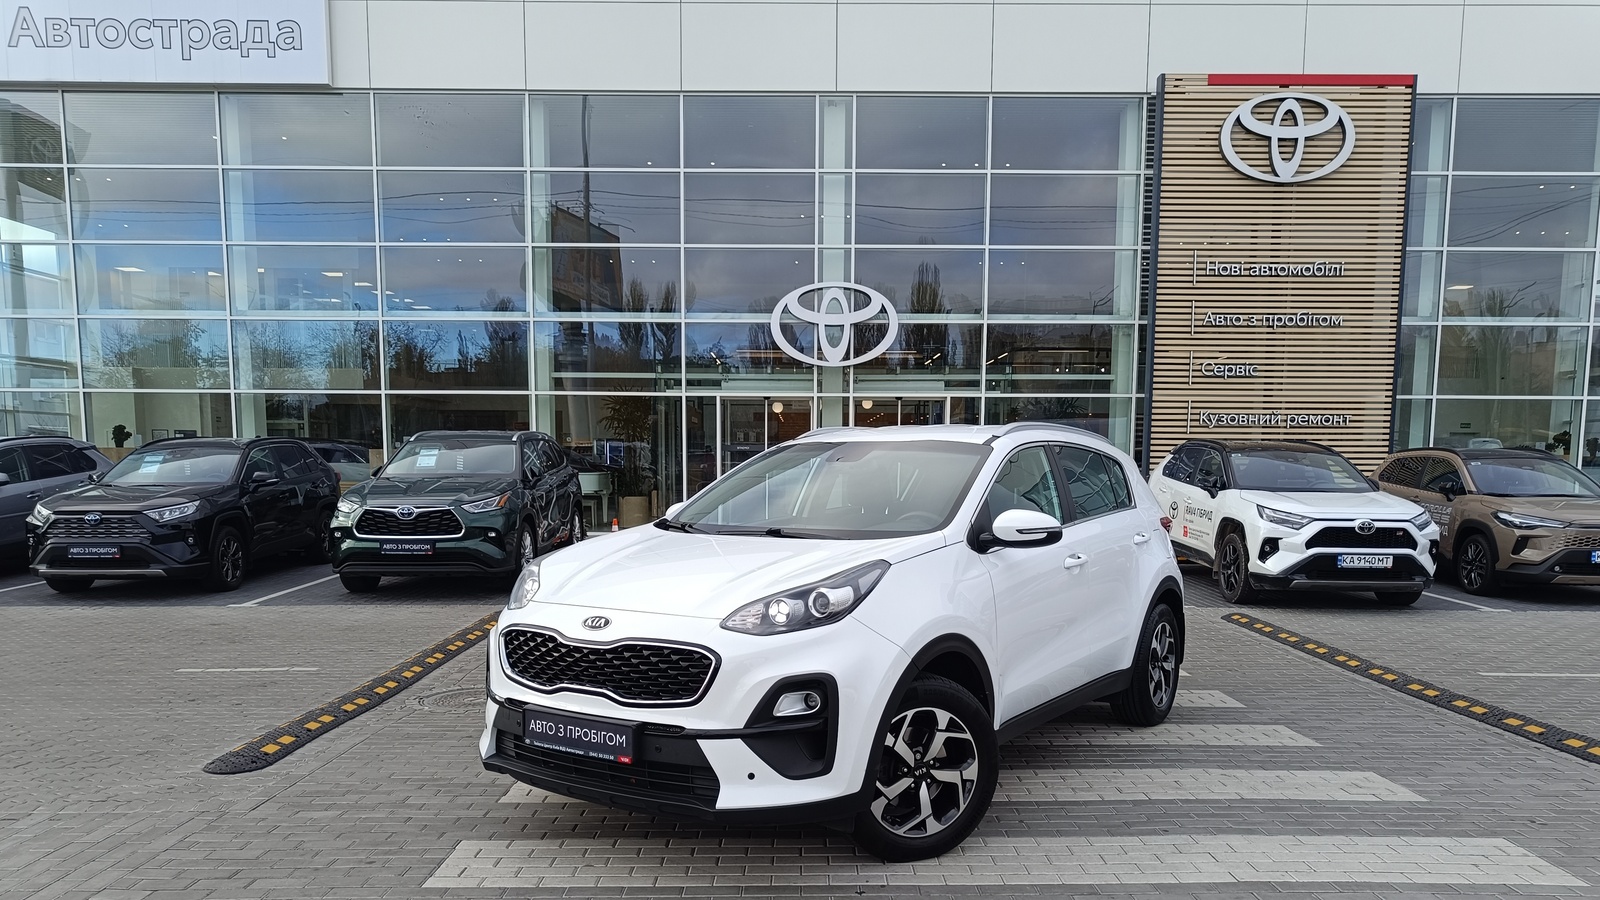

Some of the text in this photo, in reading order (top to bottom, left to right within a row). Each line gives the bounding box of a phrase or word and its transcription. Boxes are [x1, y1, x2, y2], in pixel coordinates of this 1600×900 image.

[7, 6, 303, 61] Автострада
[1205, 260, 1345, 276] Нові автомобілі
[1203, 310, 1344, 330] Авто з пробігом
[1201, 361, 1259, 380] Сервіс
[1199, 410, 1352, 429] Кузовний ремонт
[1342, 556, 1391, 565] KA 9140 MT
[585, 617, 606, 627] KIA
[529, 719, 626, 748] АВТО З ПРОБІГОМ
[914, 767, 927, 776] KIA
